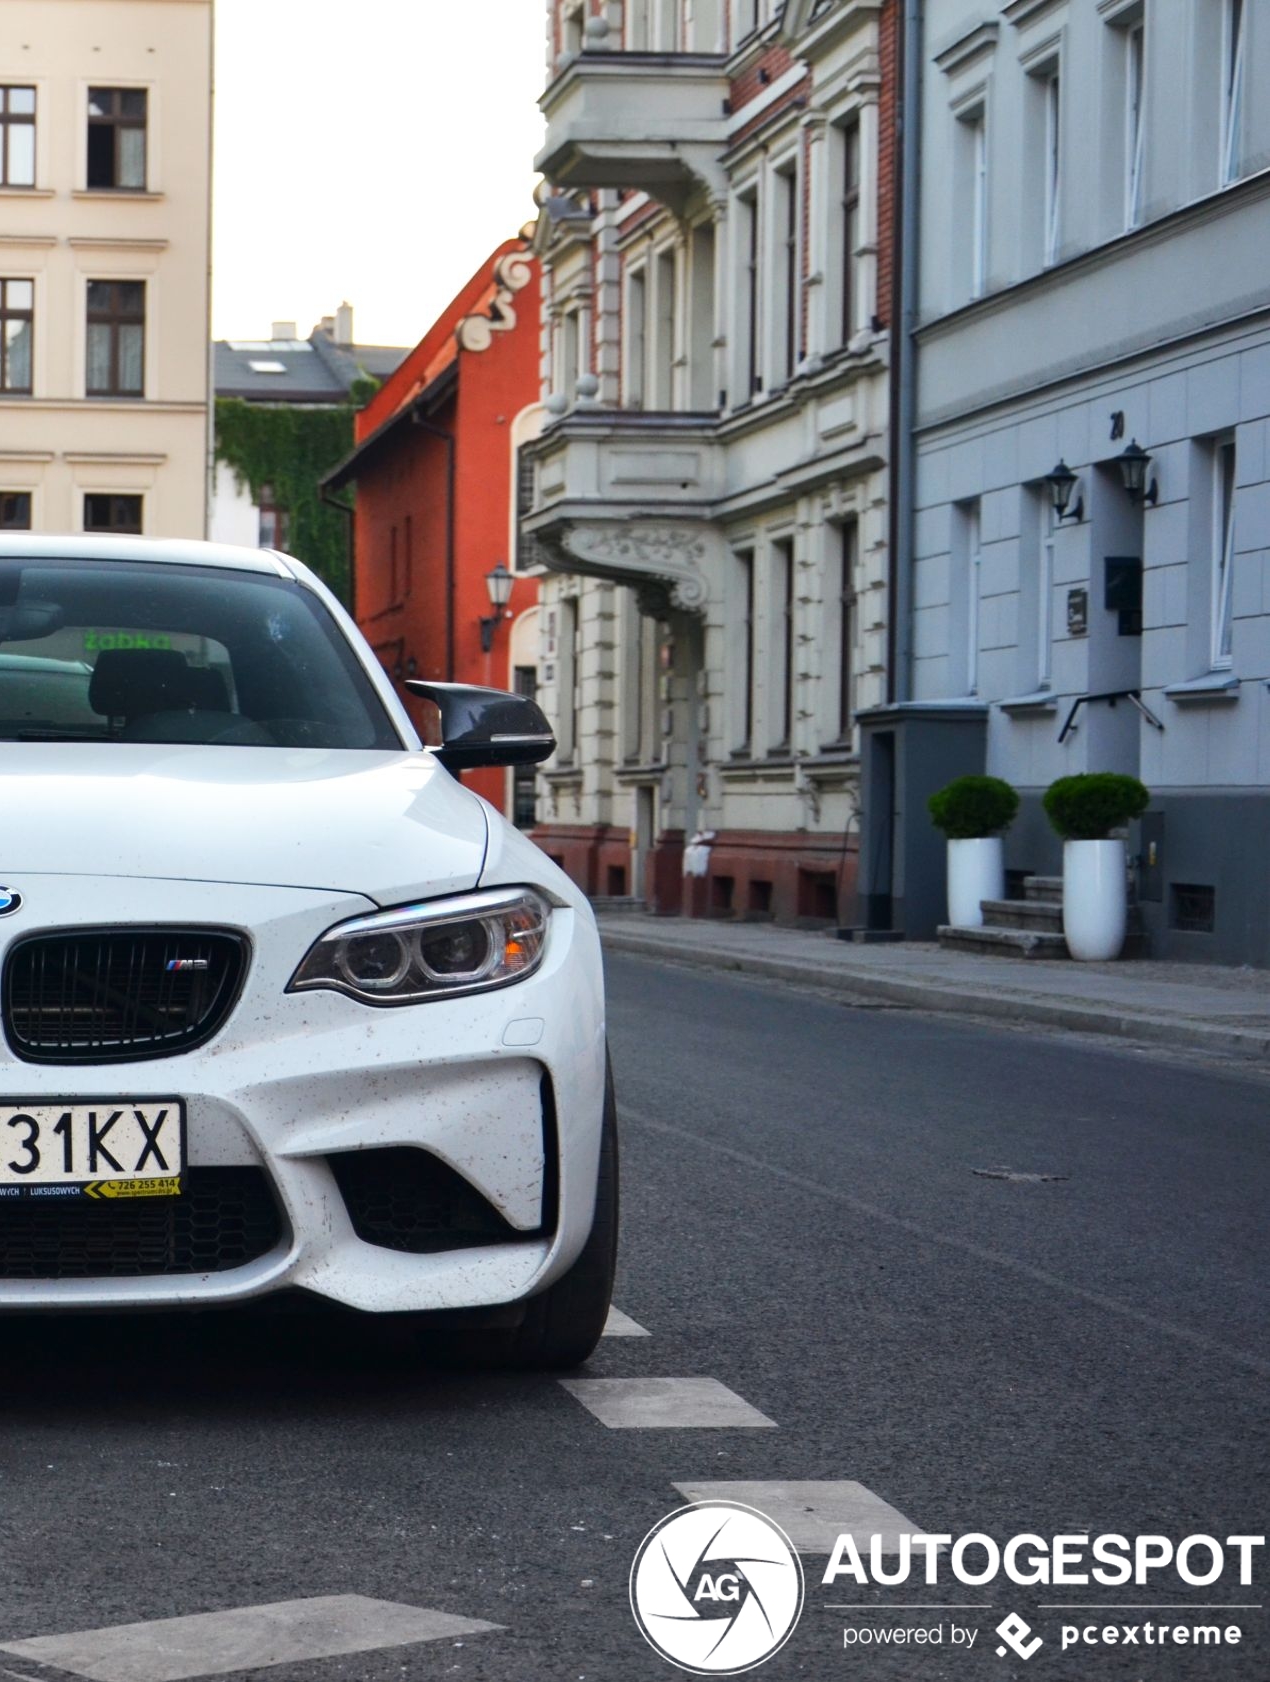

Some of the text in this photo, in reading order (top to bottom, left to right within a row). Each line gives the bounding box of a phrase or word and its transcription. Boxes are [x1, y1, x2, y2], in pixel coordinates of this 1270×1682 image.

[179, 959, 208, 970] M2
[118, 1178, 175, 1190] 726 255 414
[30, 1186, 80, 1196] LUKSUSOWYCH
